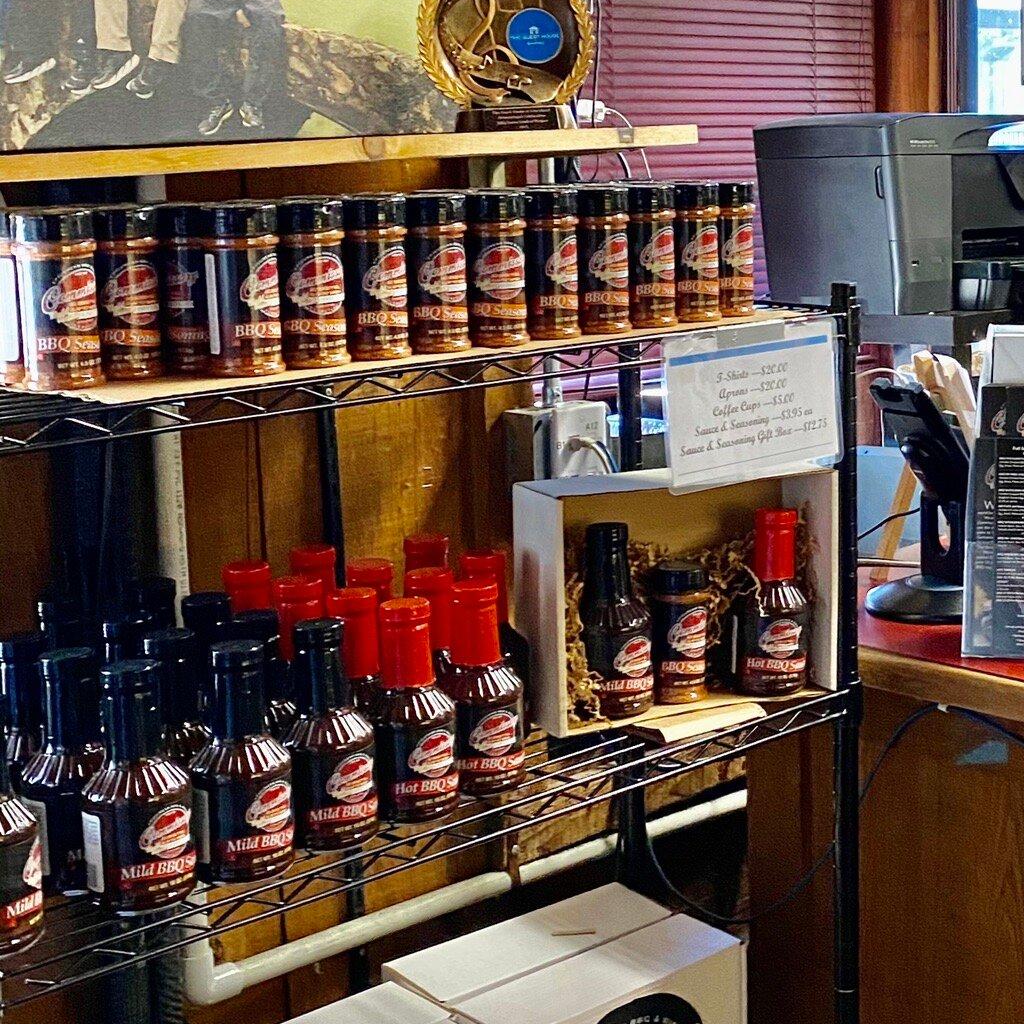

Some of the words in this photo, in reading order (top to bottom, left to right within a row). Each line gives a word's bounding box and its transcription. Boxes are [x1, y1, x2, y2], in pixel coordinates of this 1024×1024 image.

[585, 291, 611, 305] BBQ
[636, 284, 661, 297] BBQ
[540, 296, 567, 309] BBQ
[358, 312, 388, 326] BBQ
[413, 306, 441, 320] BBQ
[235, 324, 266, 339] BBQ
[37, 337, 71, 353] BBQ
[718, 387, 749, 400] Aprons
[712, 404, 739, 417] Coffee
[740, 400, 762, 414] Cups
[694, 425, 719, 437] Sauce
[730, 415, 770, 429] Seasoning
[679, 445, 705, 457] Sauce
[716, 436, 756, 451] Seasoning
[757, 429, 774, 442] Gift
[775, 426, 793, 438] Box
[766, 659, 789, 672] BBQ
[481, 757, 507, 771] BBQ
[395, 782, 419, 795] Hot
[420, 778, 446, 792] BBQ
[309, 807, 340, 823] Mild
[342, 803, 368, 819] BBQ
[226, 836, 259, 854] Mild
[261, 832, 285, 848] BBQ
[120, 862, 155, 881] Mild
[157, 857, 184, 876] BBQ
[6, 896, 34, 918] Mild
